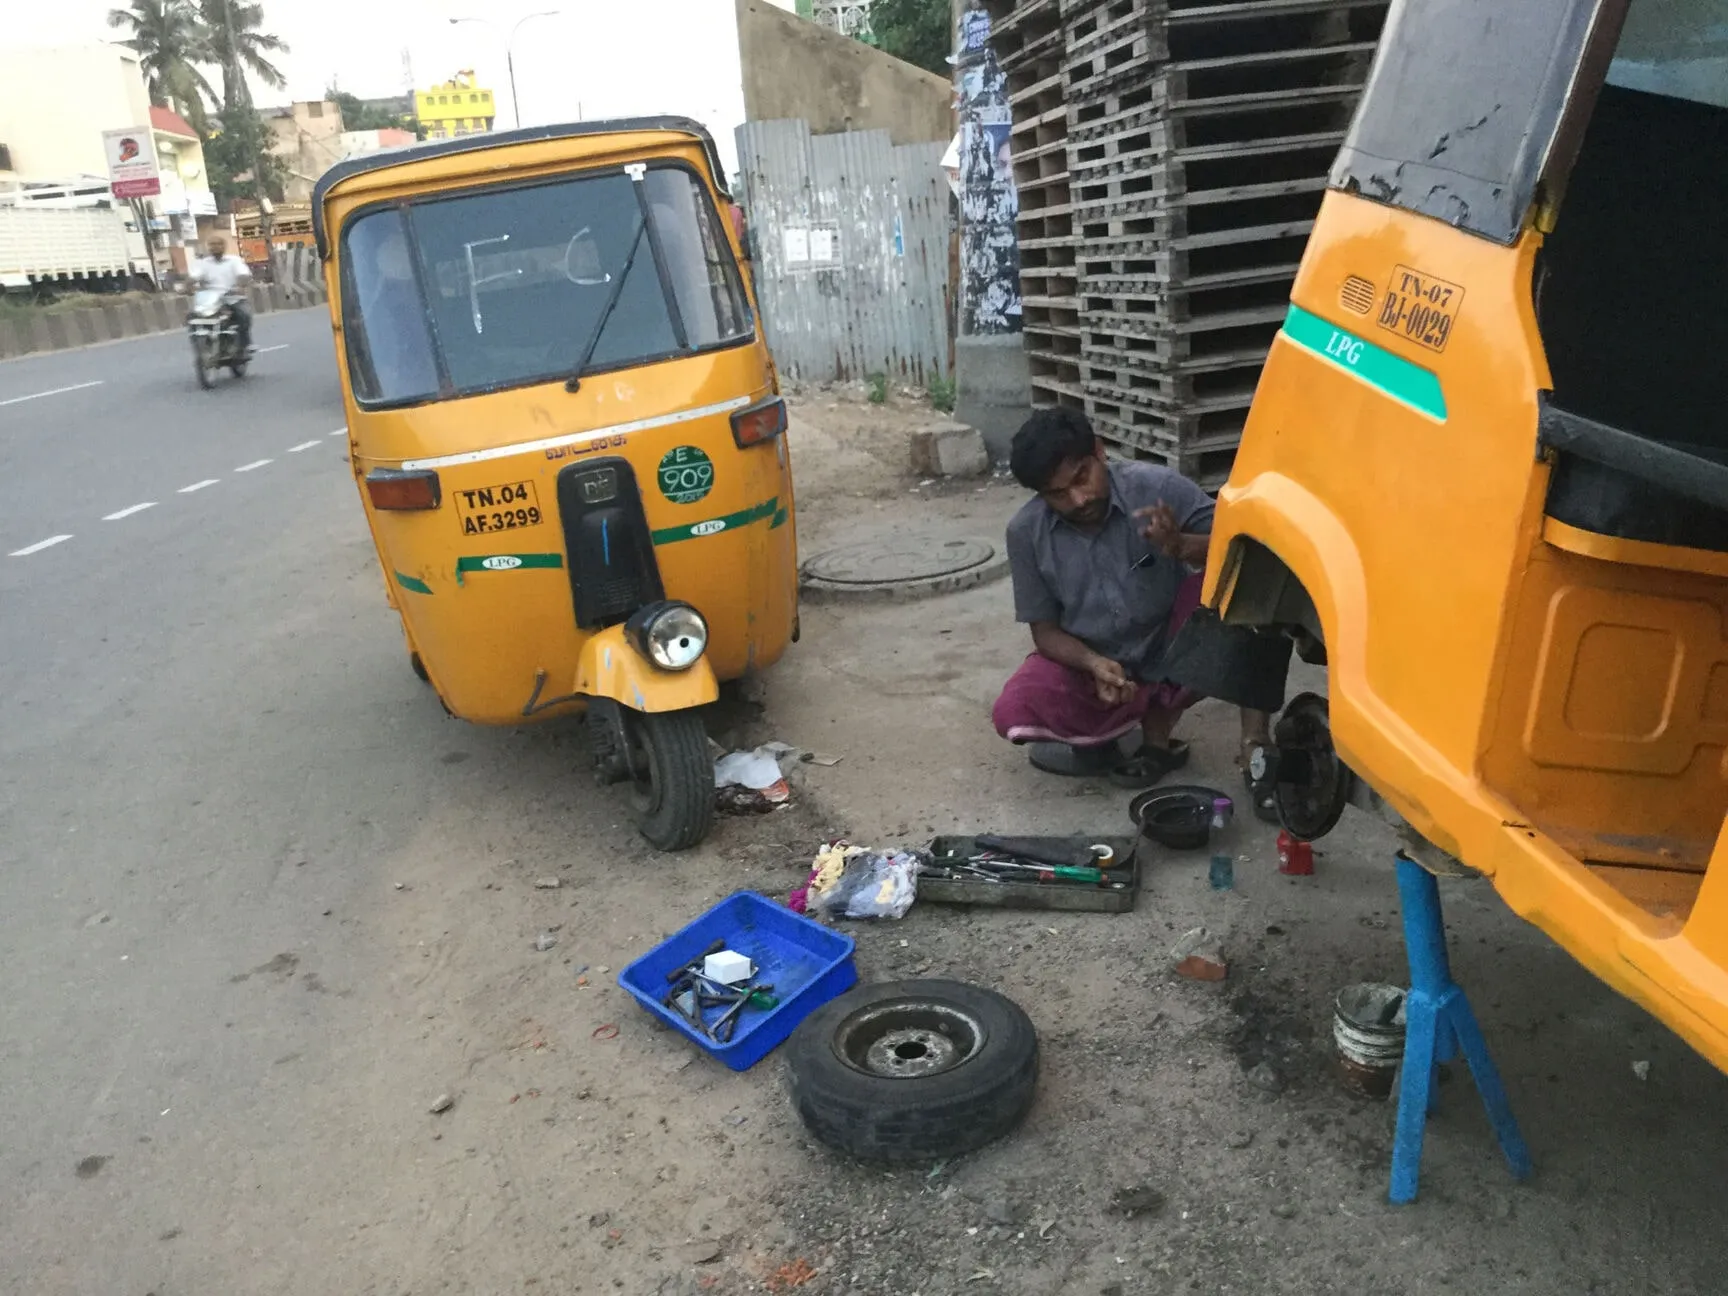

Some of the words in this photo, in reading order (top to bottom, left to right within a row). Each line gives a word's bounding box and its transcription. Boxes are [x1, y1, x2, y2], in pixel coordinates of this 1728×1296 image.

[1400, 271, 1454, 308] TN-07
[1379, 292, 1451, 348] BJ-0029
[1324, 331, 1364, 365] LPG
[664, 465, 712, 492] 909
[463, 483, 528, 509] TN.04
[465, 506, 540, 534] AF.3299
[697, 522, 722, 534] LPG
[489, 557, 517, 568] LPG
